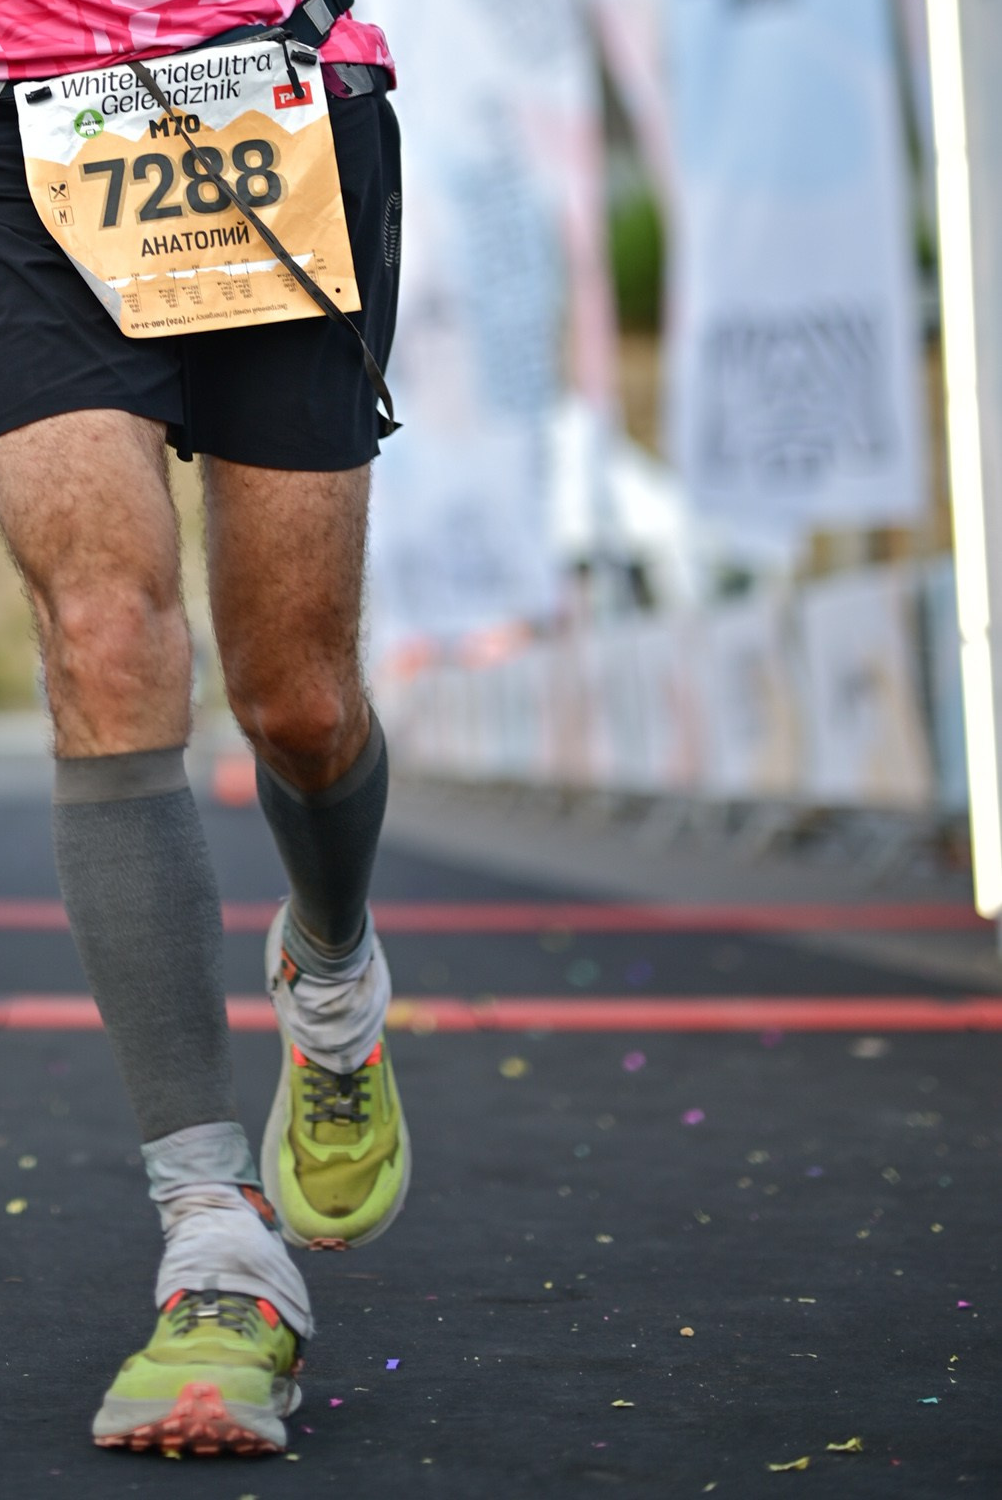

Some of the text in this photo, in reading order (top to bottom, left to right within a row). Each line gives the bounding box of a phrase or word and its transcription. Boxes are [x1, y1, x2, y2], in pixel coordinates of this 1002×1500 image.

[101, 78, 242, 116] Gelendzhik
[148, 113, 201, 139] M70
[81, 138, 284, 229] 7288
[141, 221, 250, 257] АНАТОЛИЙ
